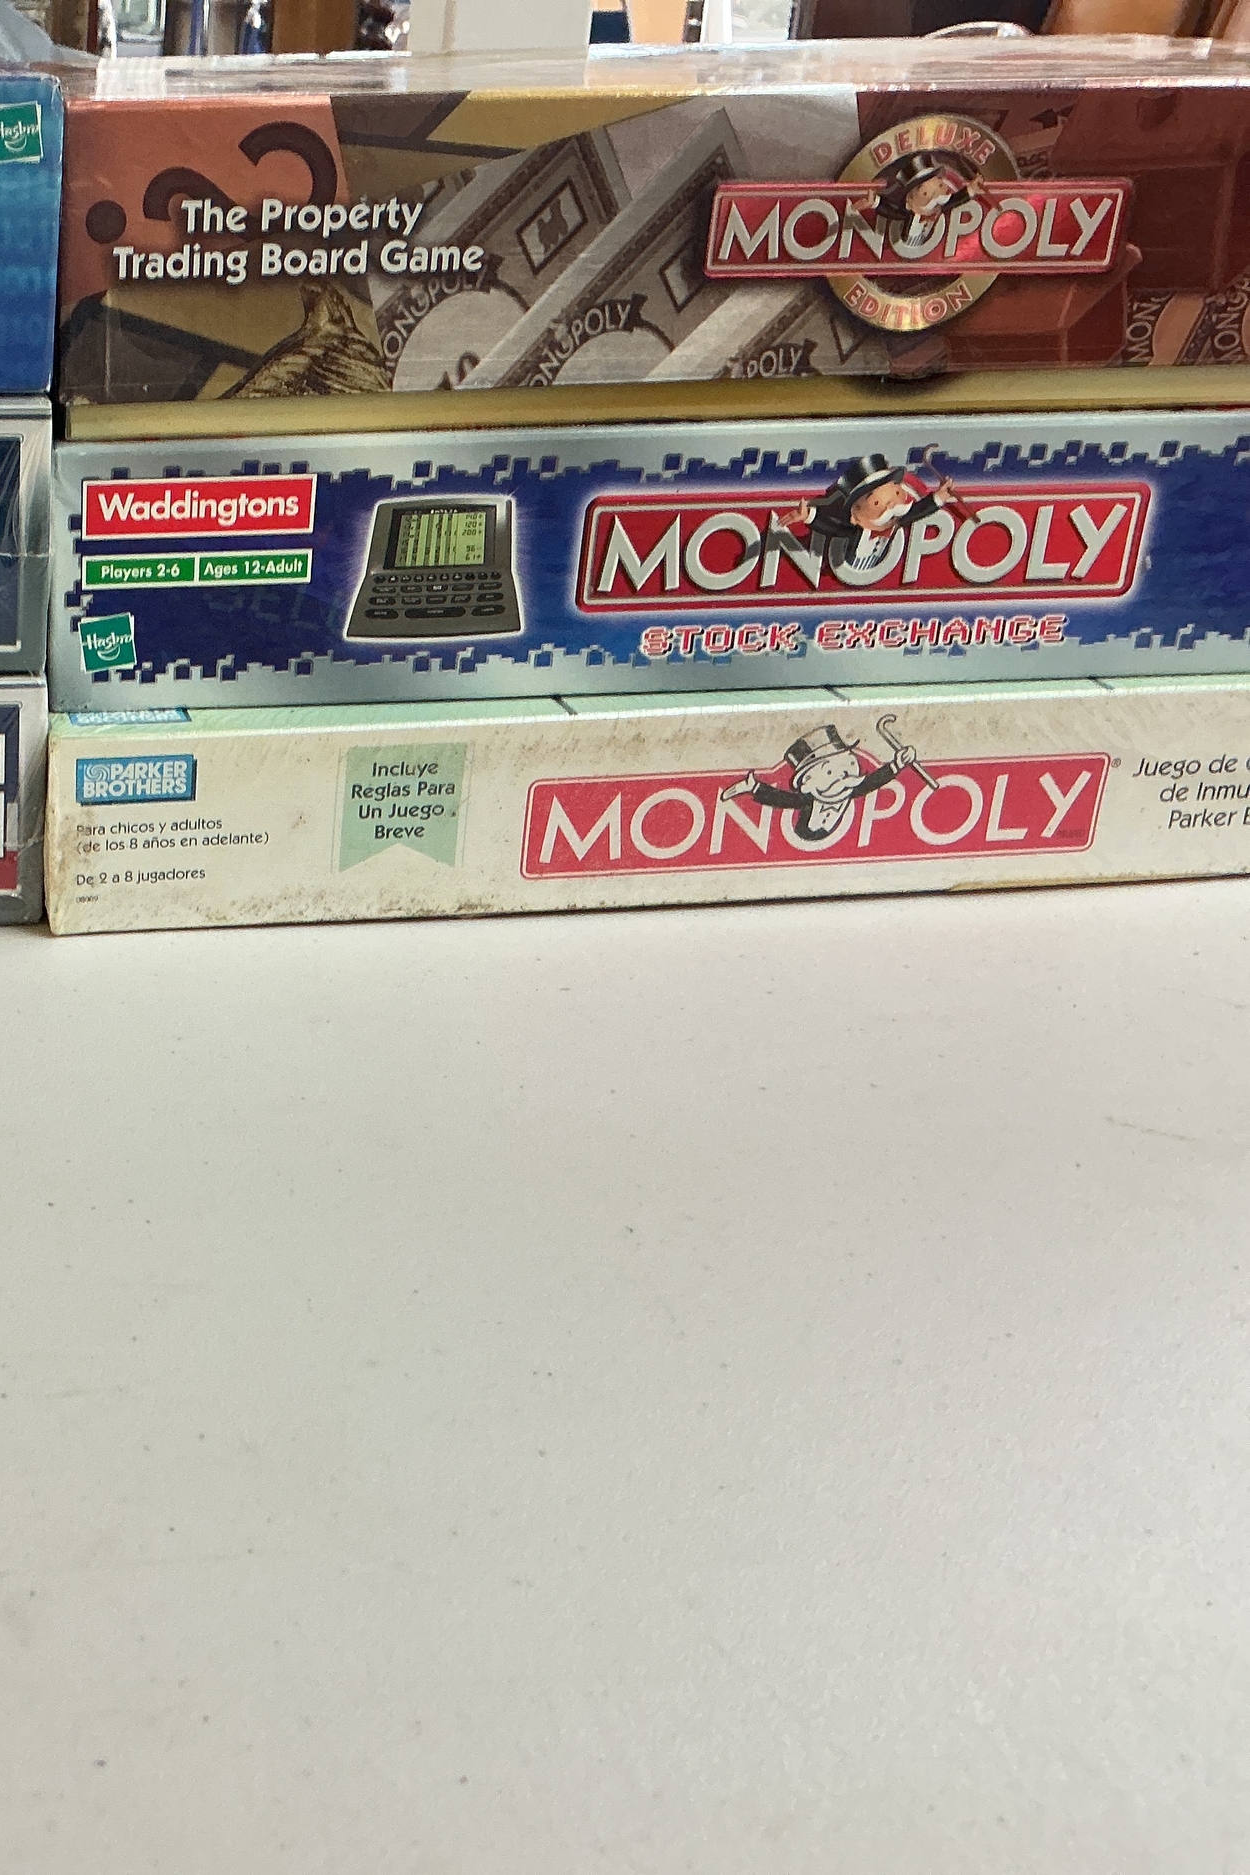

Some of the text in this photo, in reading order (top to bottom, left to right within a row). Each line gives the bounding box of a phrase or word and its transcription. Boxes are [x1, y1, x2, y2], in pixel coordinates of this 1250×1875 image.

[872, 122, 996, 166] DELUXE
[181, 198, 423, 238] The Property
[718, 196, 1113, 261] MONOPOLY
[113, 239, 485, 285] Trading Board Game
[844, 281, 973, 327] EDITION
[98, 489, 299, 527] Waddingtons
[596, 502, 1127, 594] MONOPOLY
[101, 563, 181, 581] Players 2-6
[203, 558, 303, 578] Ages 12-Adult
[82, 632, 133, 650] Hasbro
[642, 613, 1068, 655] STOCK EXCHANGE
[110, 761, 188, 780] PARKER
[372, 761, 439, 778] Incluye
[1132, 757, 1202, 780] Juego
[1208, 753, 1238, 774] de
[83, 777, 187, 798] BROTHERS
[351, 781, 456, 802] Reglas Para
[1159, 782, 1190, 802] de
[358, 803, 445, 820] Un Juego
[538, 769, 1092, 864] MONOPOLY
[1168, 808, 1238, 829] Parker
[76, 817, 223, 838] Para chicos y adultos
[374, 824, 425, 839] Breve
[105, 839, 126, 851] los
[129, 838, 138, 850] 8
[143, 836, 176, 849] años
[180, 835, 198, 847] en
[202, 831, 270, 847] adelante)
[76, 867, 206, 886] De 2 a 8 jugadores
